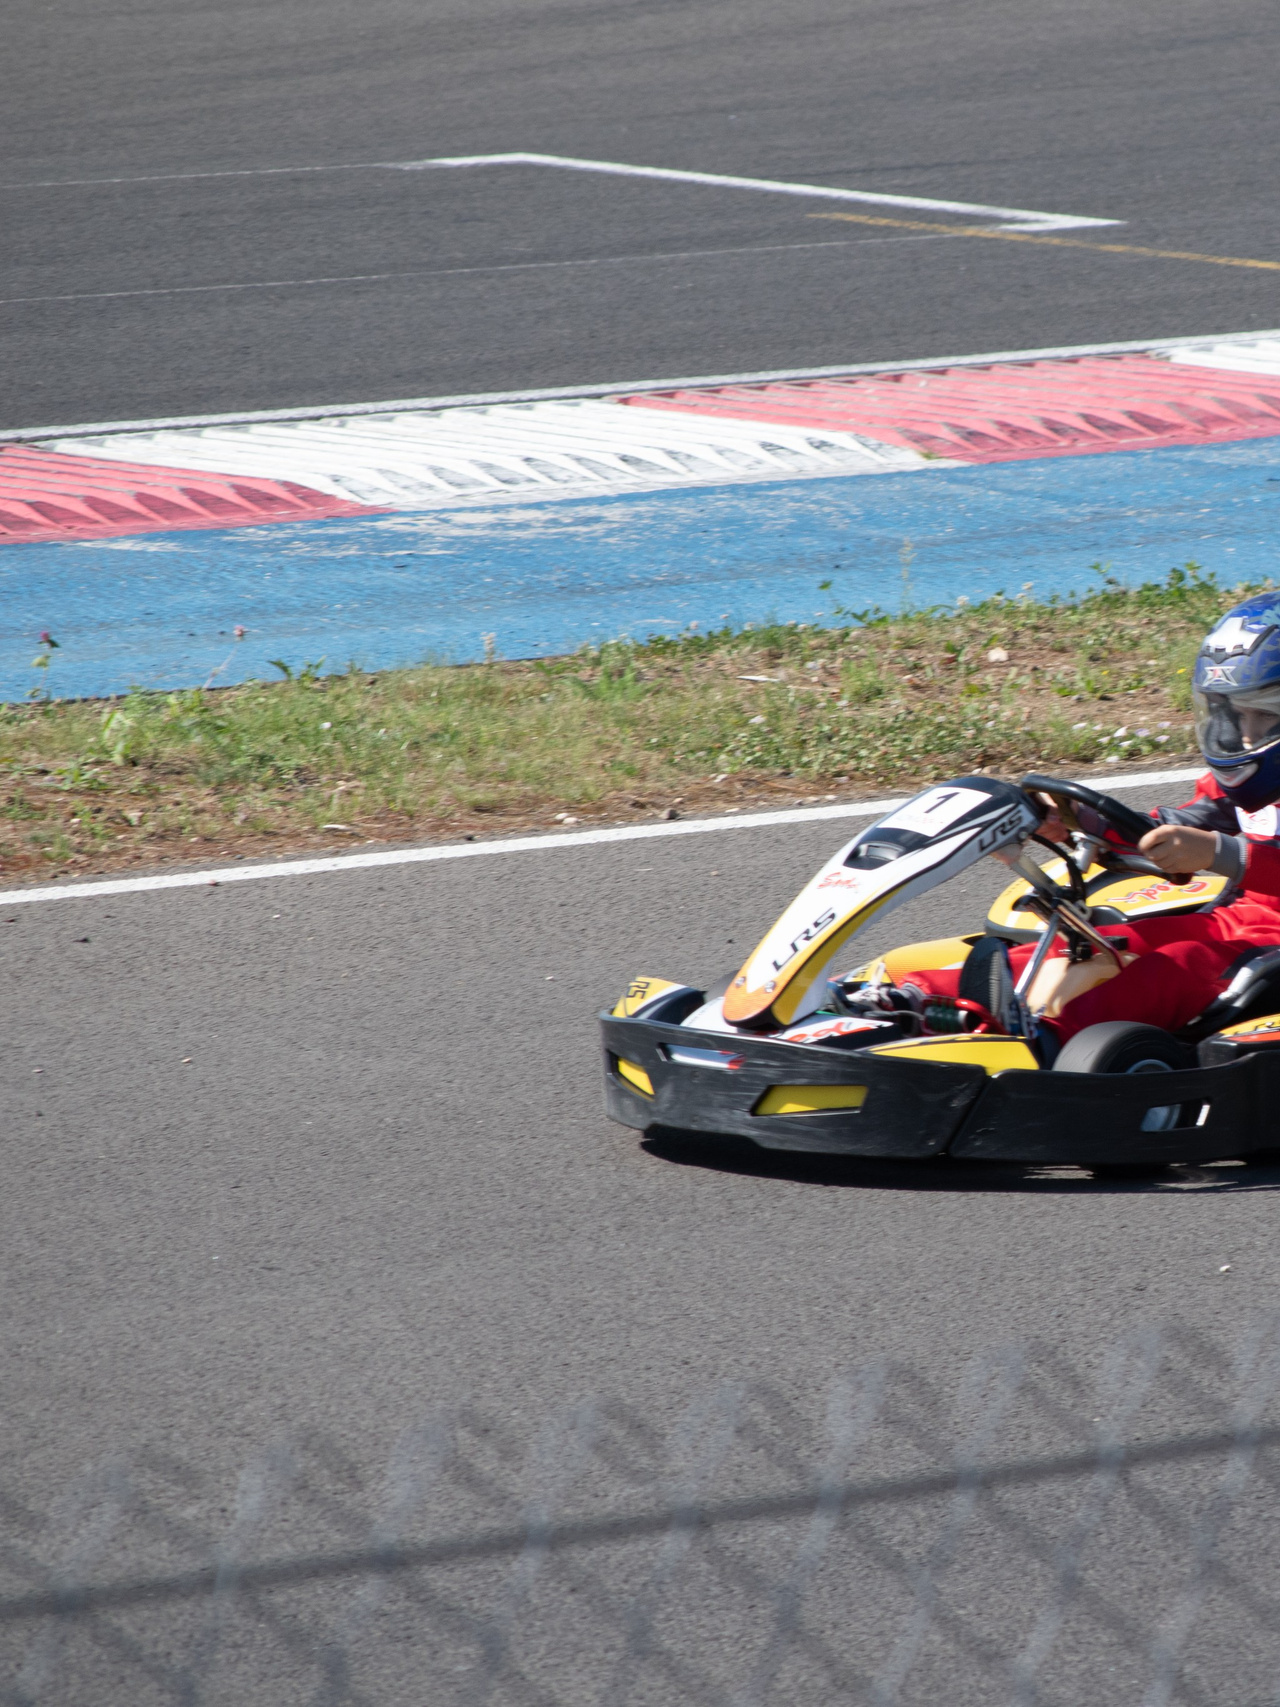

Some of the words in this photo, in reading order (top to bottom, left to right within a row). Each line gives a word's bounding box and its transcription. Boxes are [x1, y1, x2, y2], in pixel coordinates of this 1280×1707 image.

[923, 791, 961, 814] 1
[979, 808, 1022, 851] LRS
[772, 906, 836, 972] LRS
